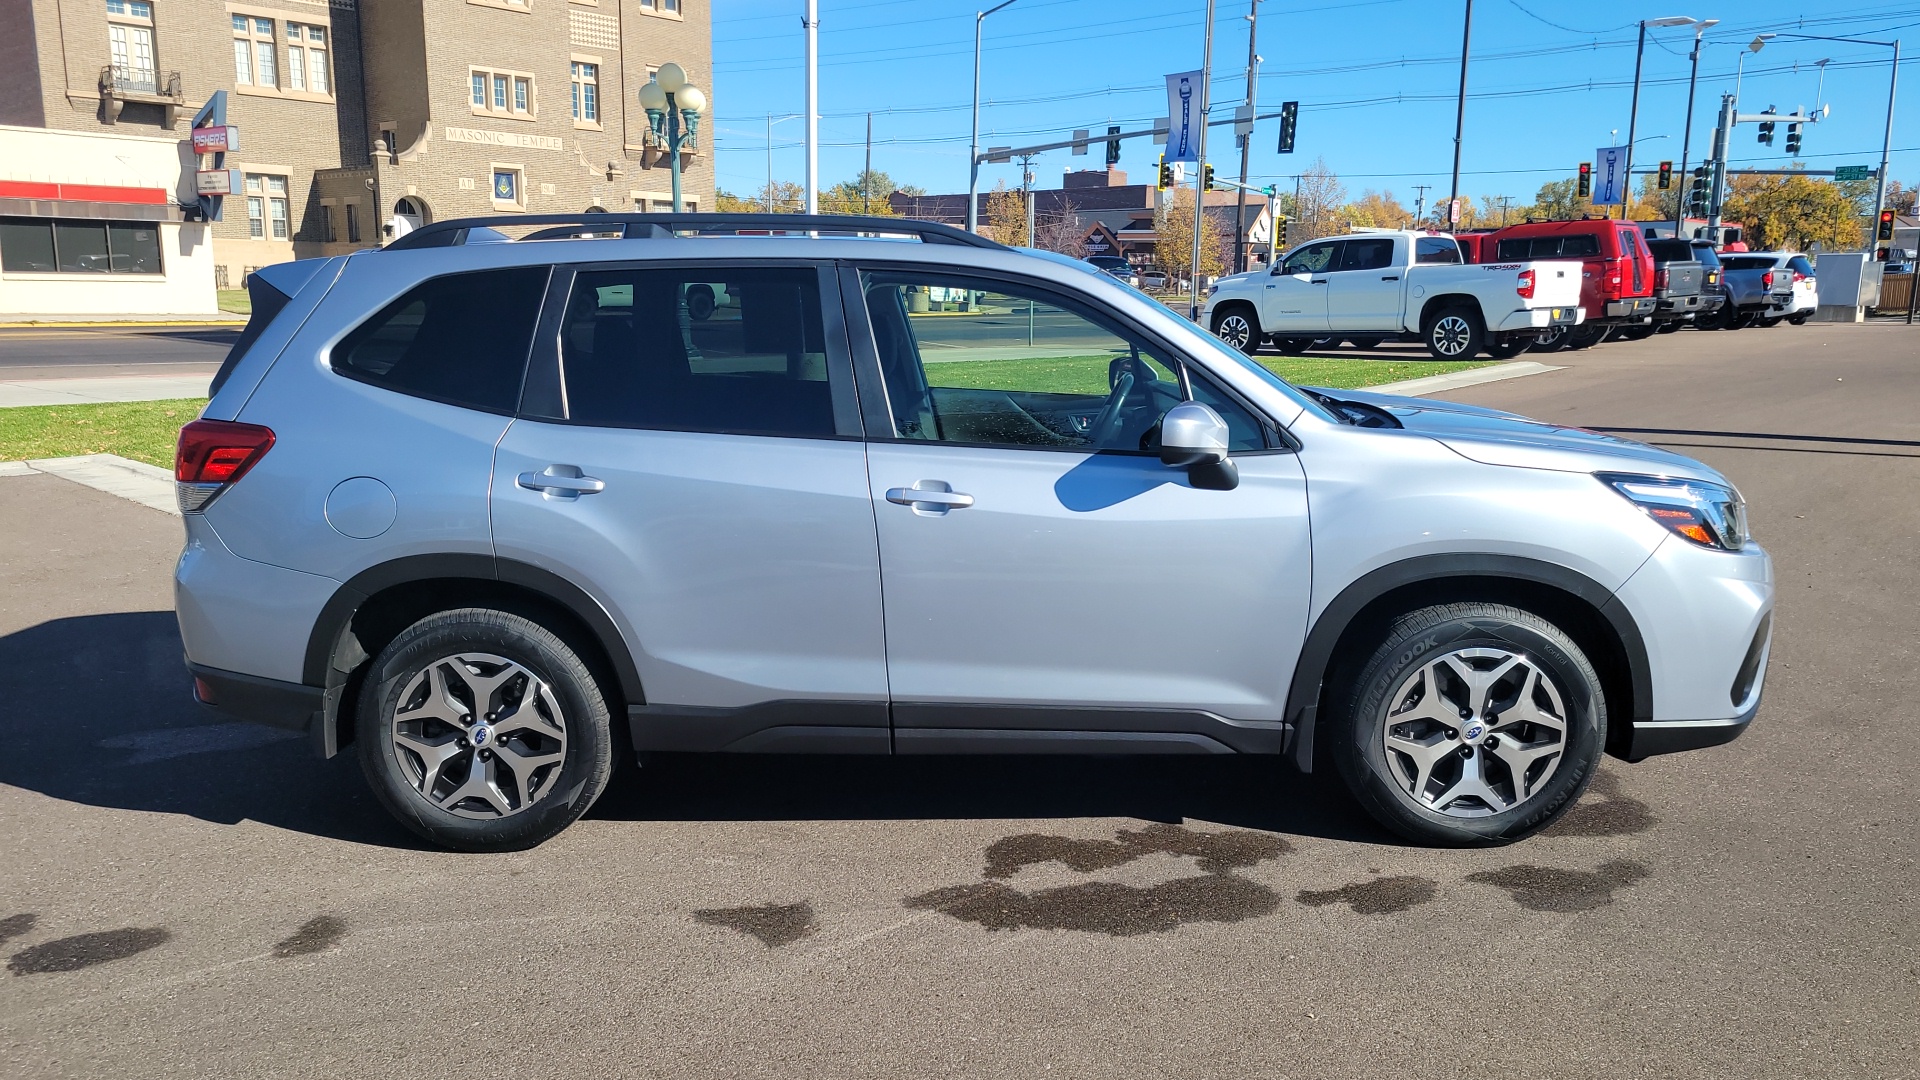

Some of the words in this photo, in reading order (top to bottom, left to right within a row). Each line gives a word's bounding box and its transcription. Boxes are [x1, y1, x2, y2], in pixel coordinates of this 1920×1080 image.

[448, 129, 505, 143] MASONIC
[514, 135, 560, 149] TEMPLE
[1543, 644, 1567, 665] Kontrol
